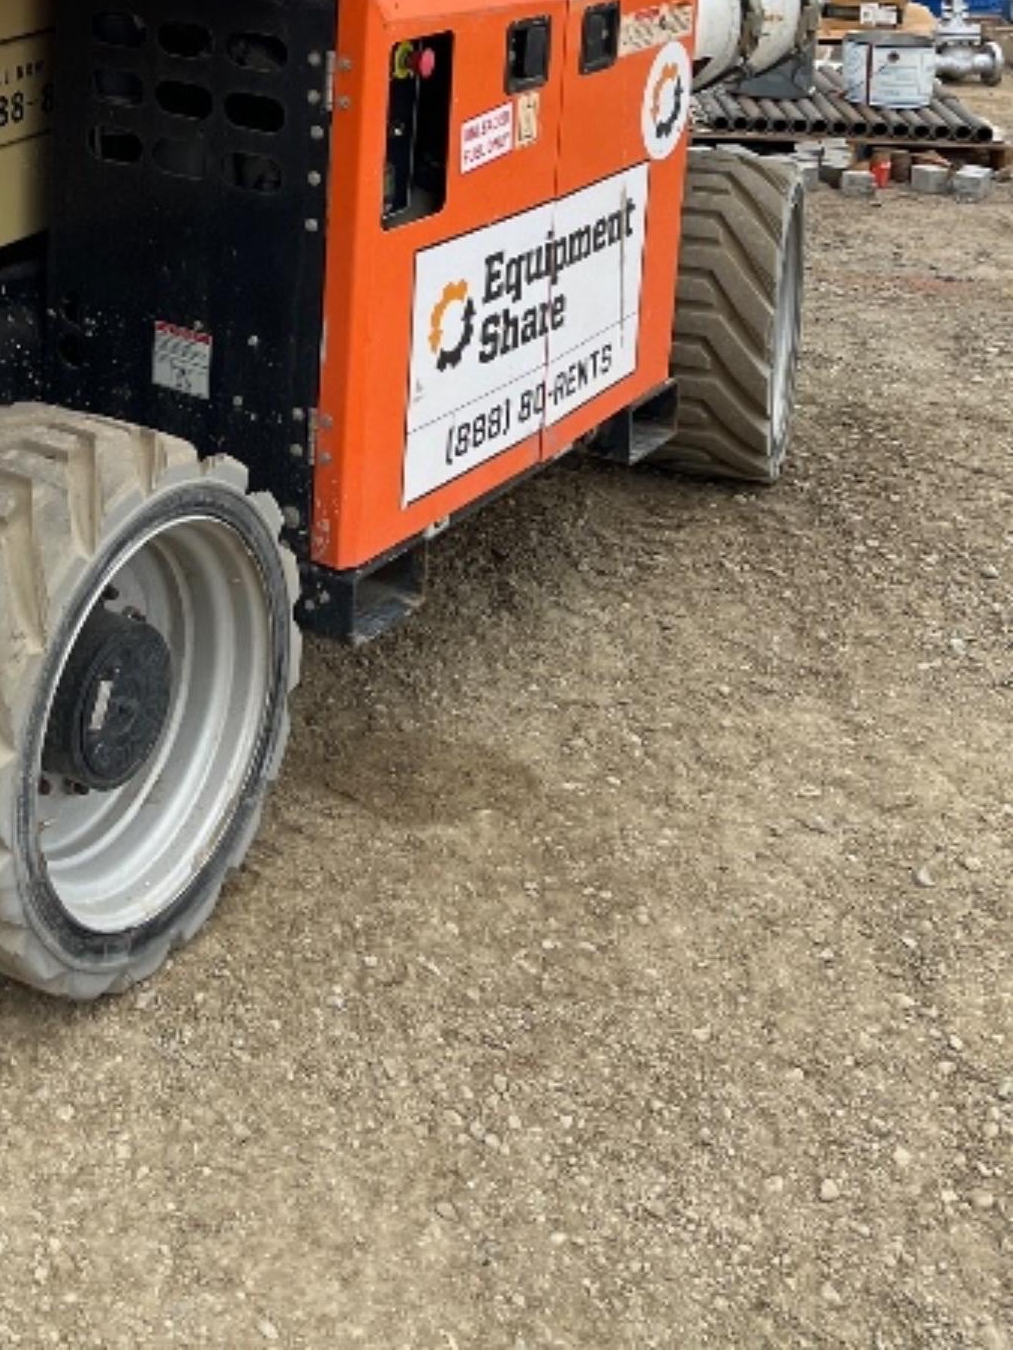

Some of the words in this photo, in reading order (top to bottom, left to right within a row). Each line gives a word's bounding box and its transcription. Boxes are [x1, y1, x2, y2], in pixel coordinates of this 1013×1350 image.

[481, 197, 636, 304] Equipment
[478, 293, 566, 364] Share
[445, 398, 511, 465] (888)
[517, 344, 613, 424] 80-RENTS
